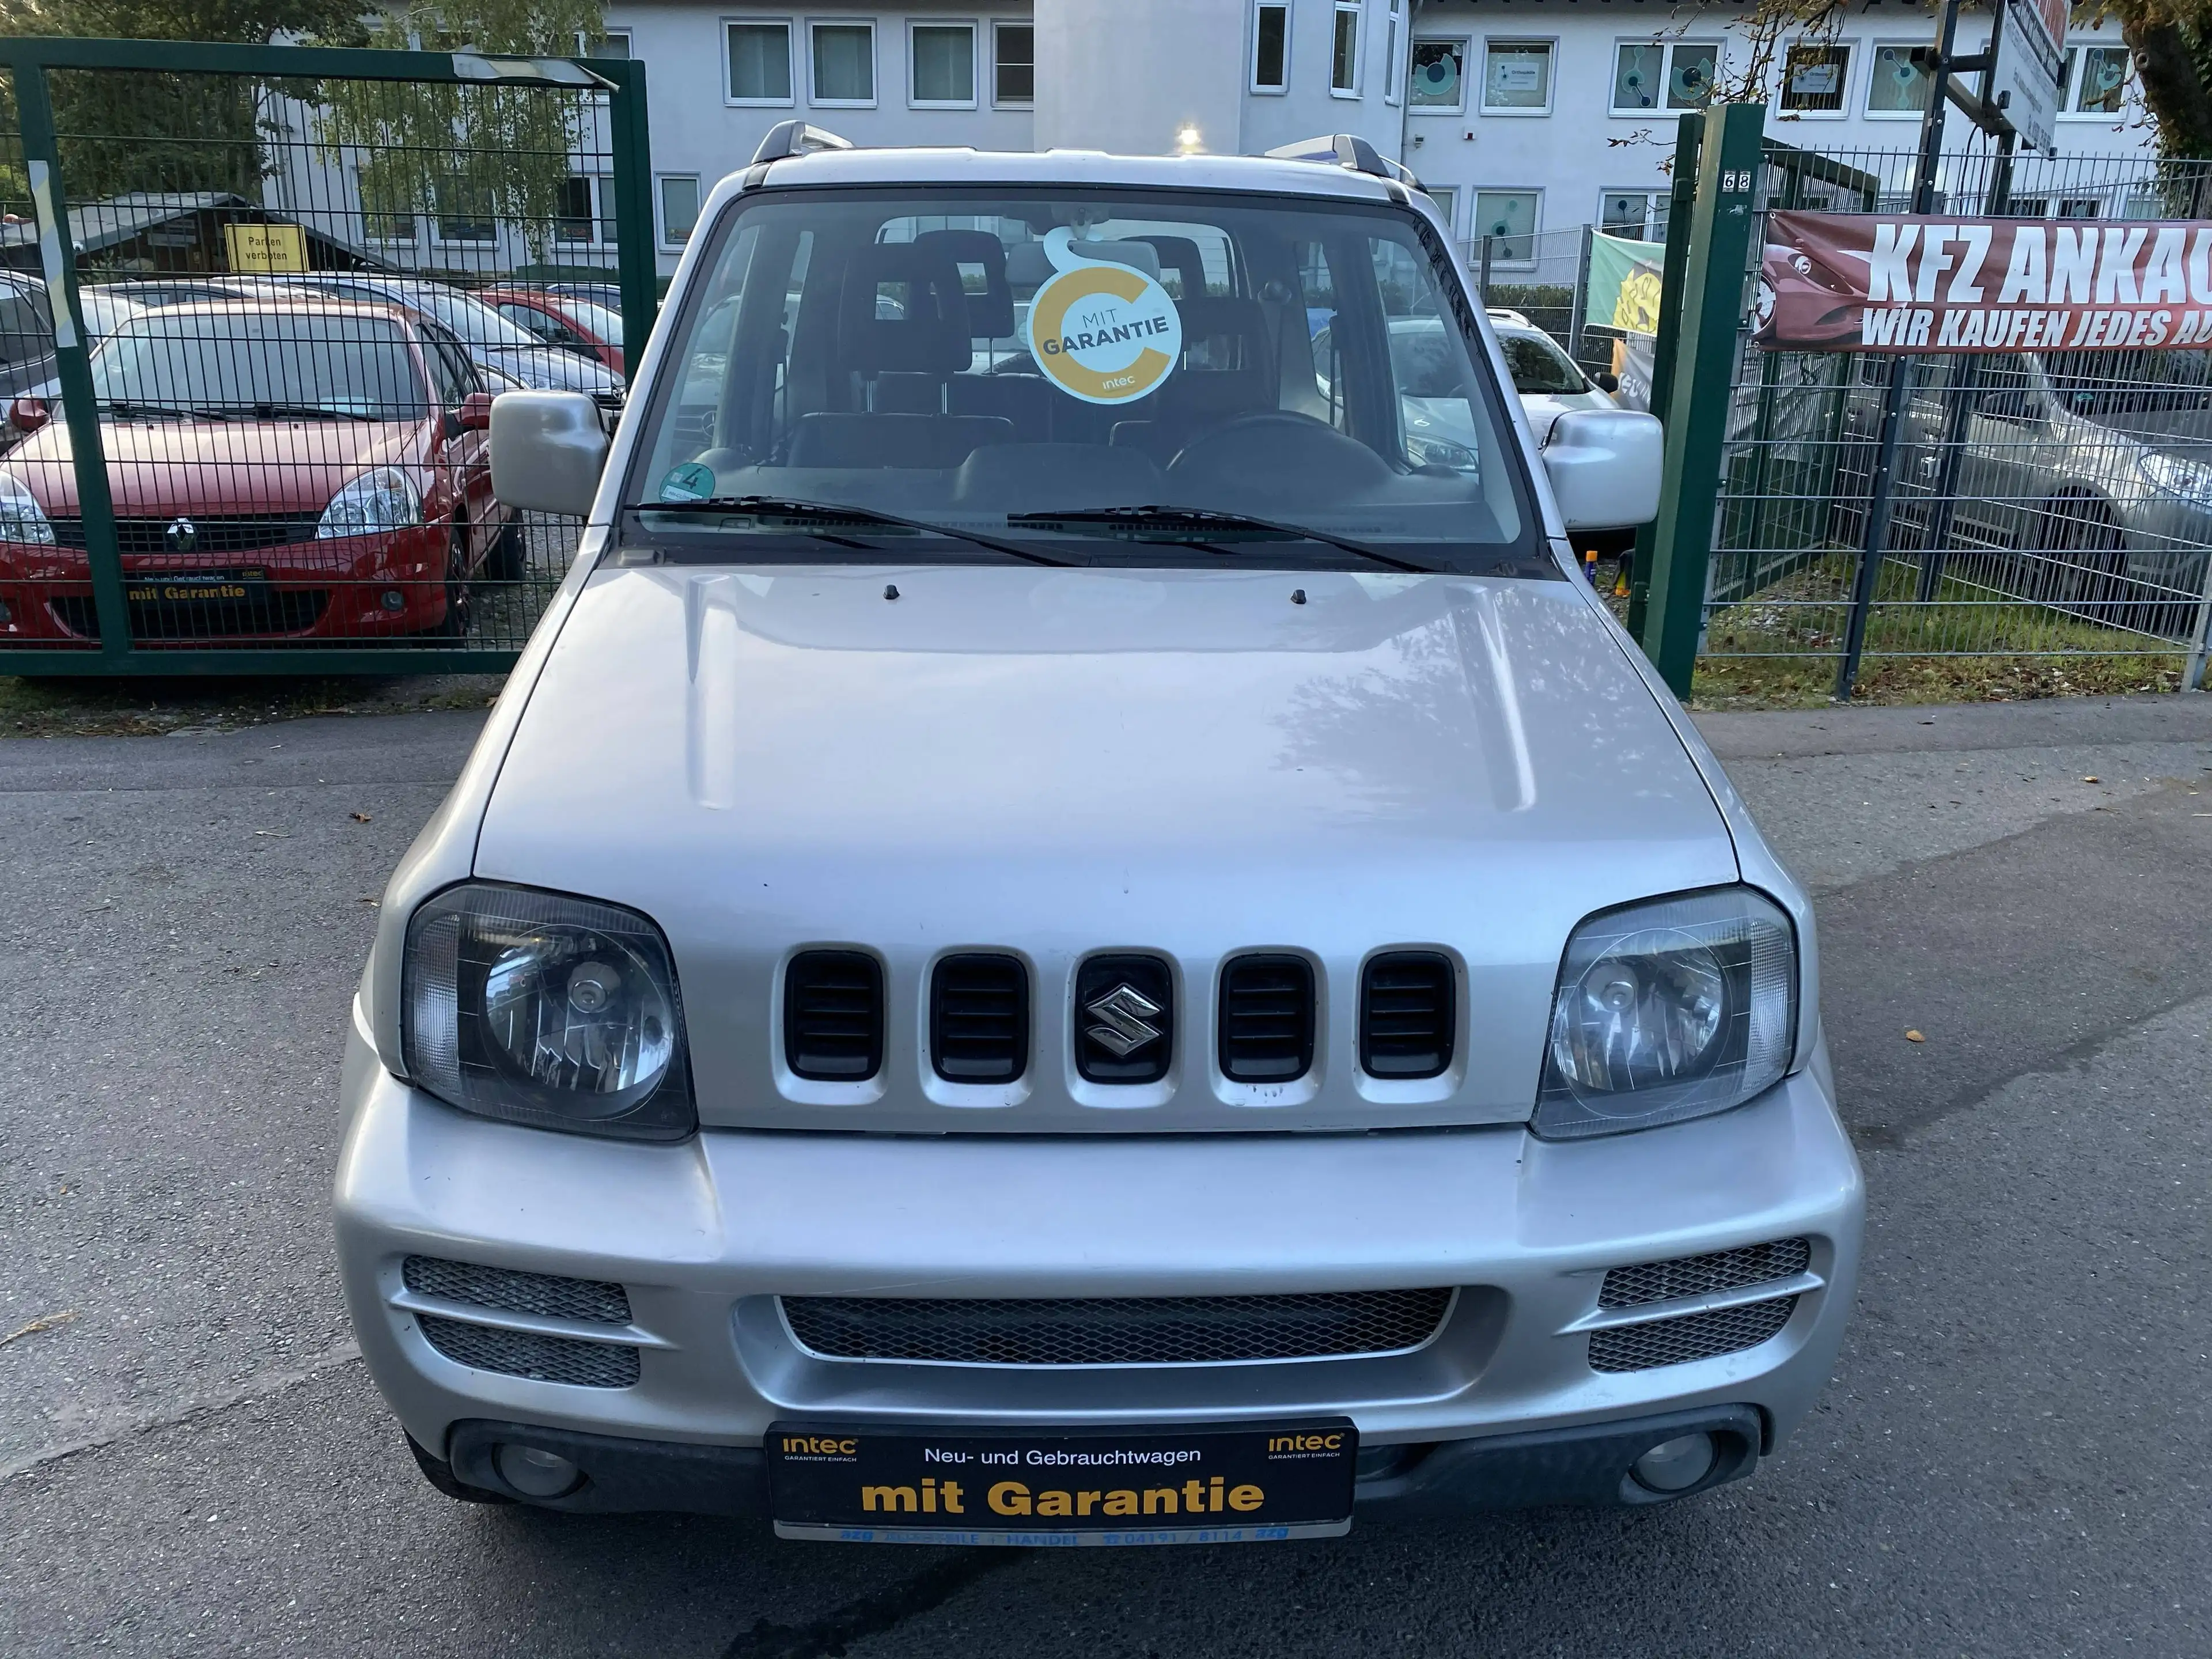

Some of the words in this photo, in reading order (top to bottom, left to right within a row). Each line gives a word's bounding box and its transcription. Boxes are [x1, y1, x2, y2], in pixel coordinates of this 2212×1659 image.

[245, 250, 287, 260] verboten
[1866, 224, 1993, 303] KFZ
[1082, 308, 1116, 328] MIT
[1043, 316, 1169, 355] GARANTIE
[1861, 308, 1934, 347] WIR
[1937, 309, 2070, 347] KAUFEN
[2069, 310, 2172, 348] JEDES
[1102, 376, 1136, 390] intec
[682, 468, 703, 490] 4
[129, 587, 158, 600] mit
[165, 584, 245, 600] Garantie
[783, 1437, 857, 1455] intec
[1268, 1434, 1341, 1452] intec
[925, 1448, 974, 1463] Neu-
[981, 1449, 1018, 1465] und
[1027, 1448, 1201, 1466] Gebrauchtwagen
[862, 1478, 964, 1513] mit
[987, 1476, 1265, 1516] Garantie
[1199, 1530, 1242, 1542] 8114
